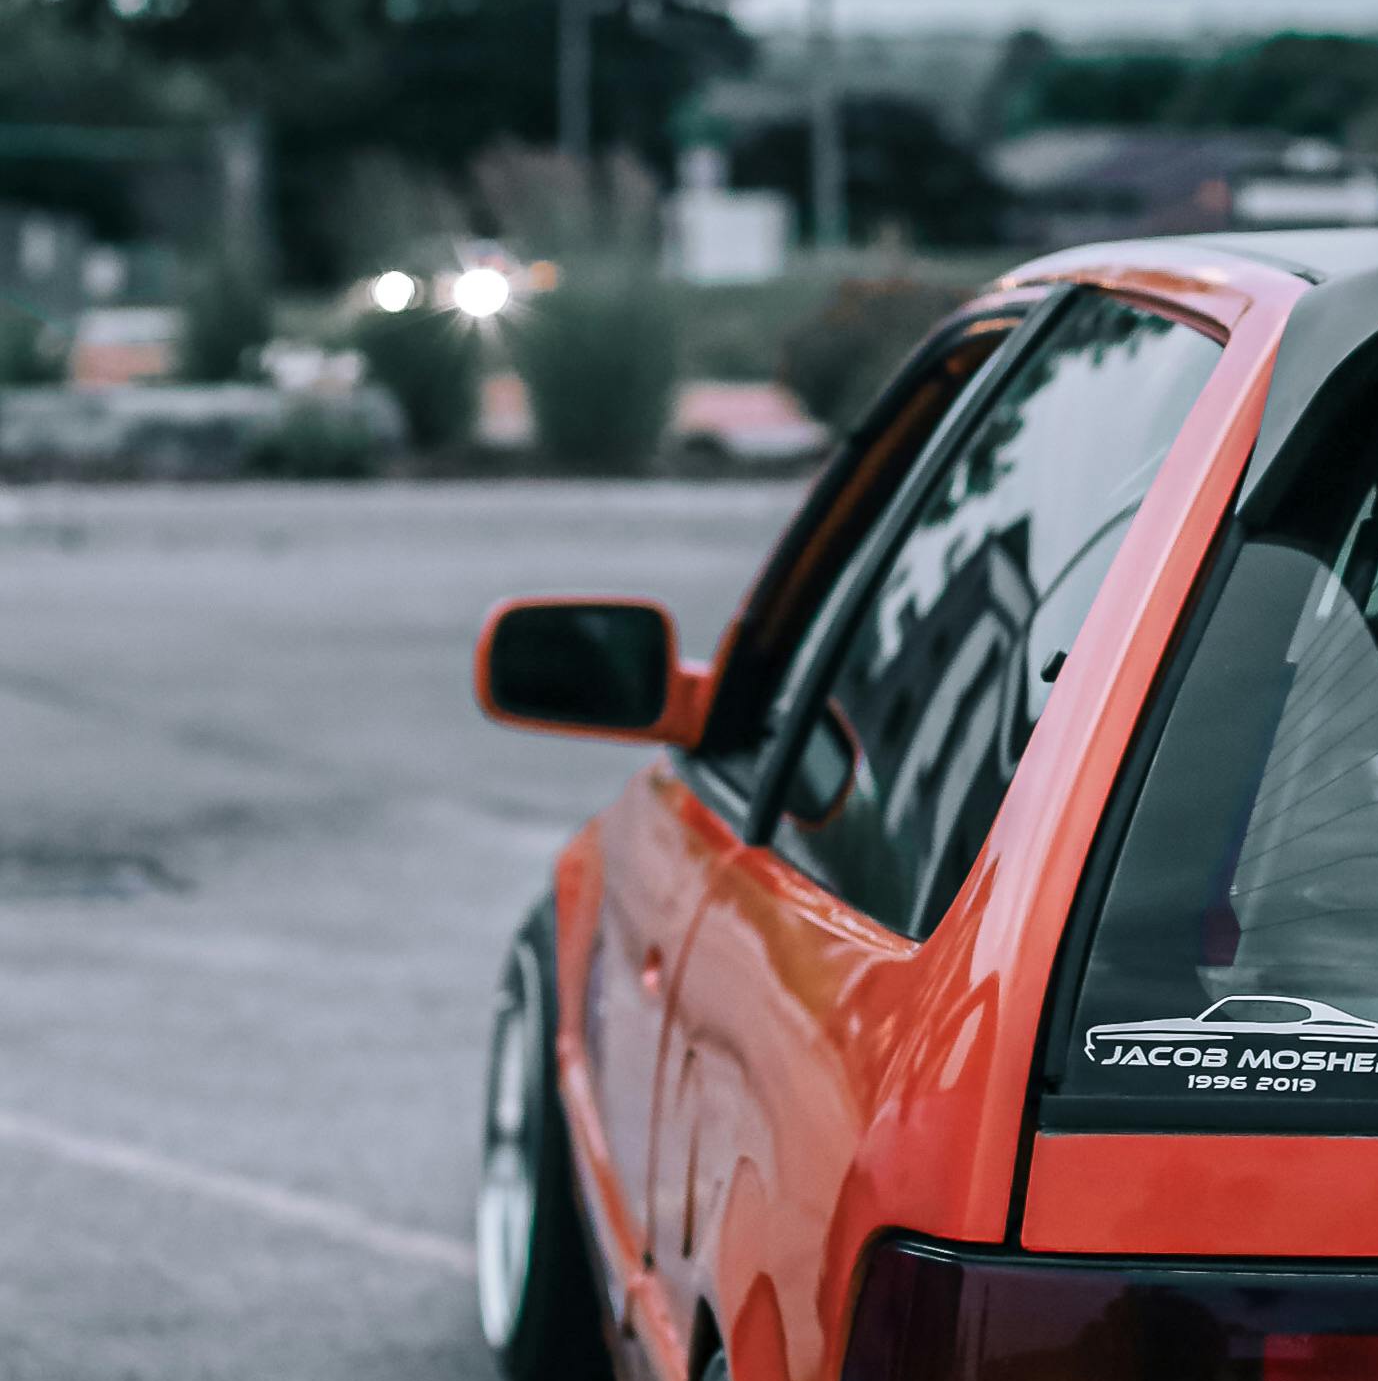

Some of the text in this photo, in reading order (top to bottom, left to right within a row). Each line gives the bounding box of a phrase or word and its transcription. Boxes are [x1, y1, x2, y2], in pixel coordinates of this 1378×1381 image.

[1100, 1045, 1229, 1068] JACOB
[1187, 1074, 1317, 1092] 1996 2019
